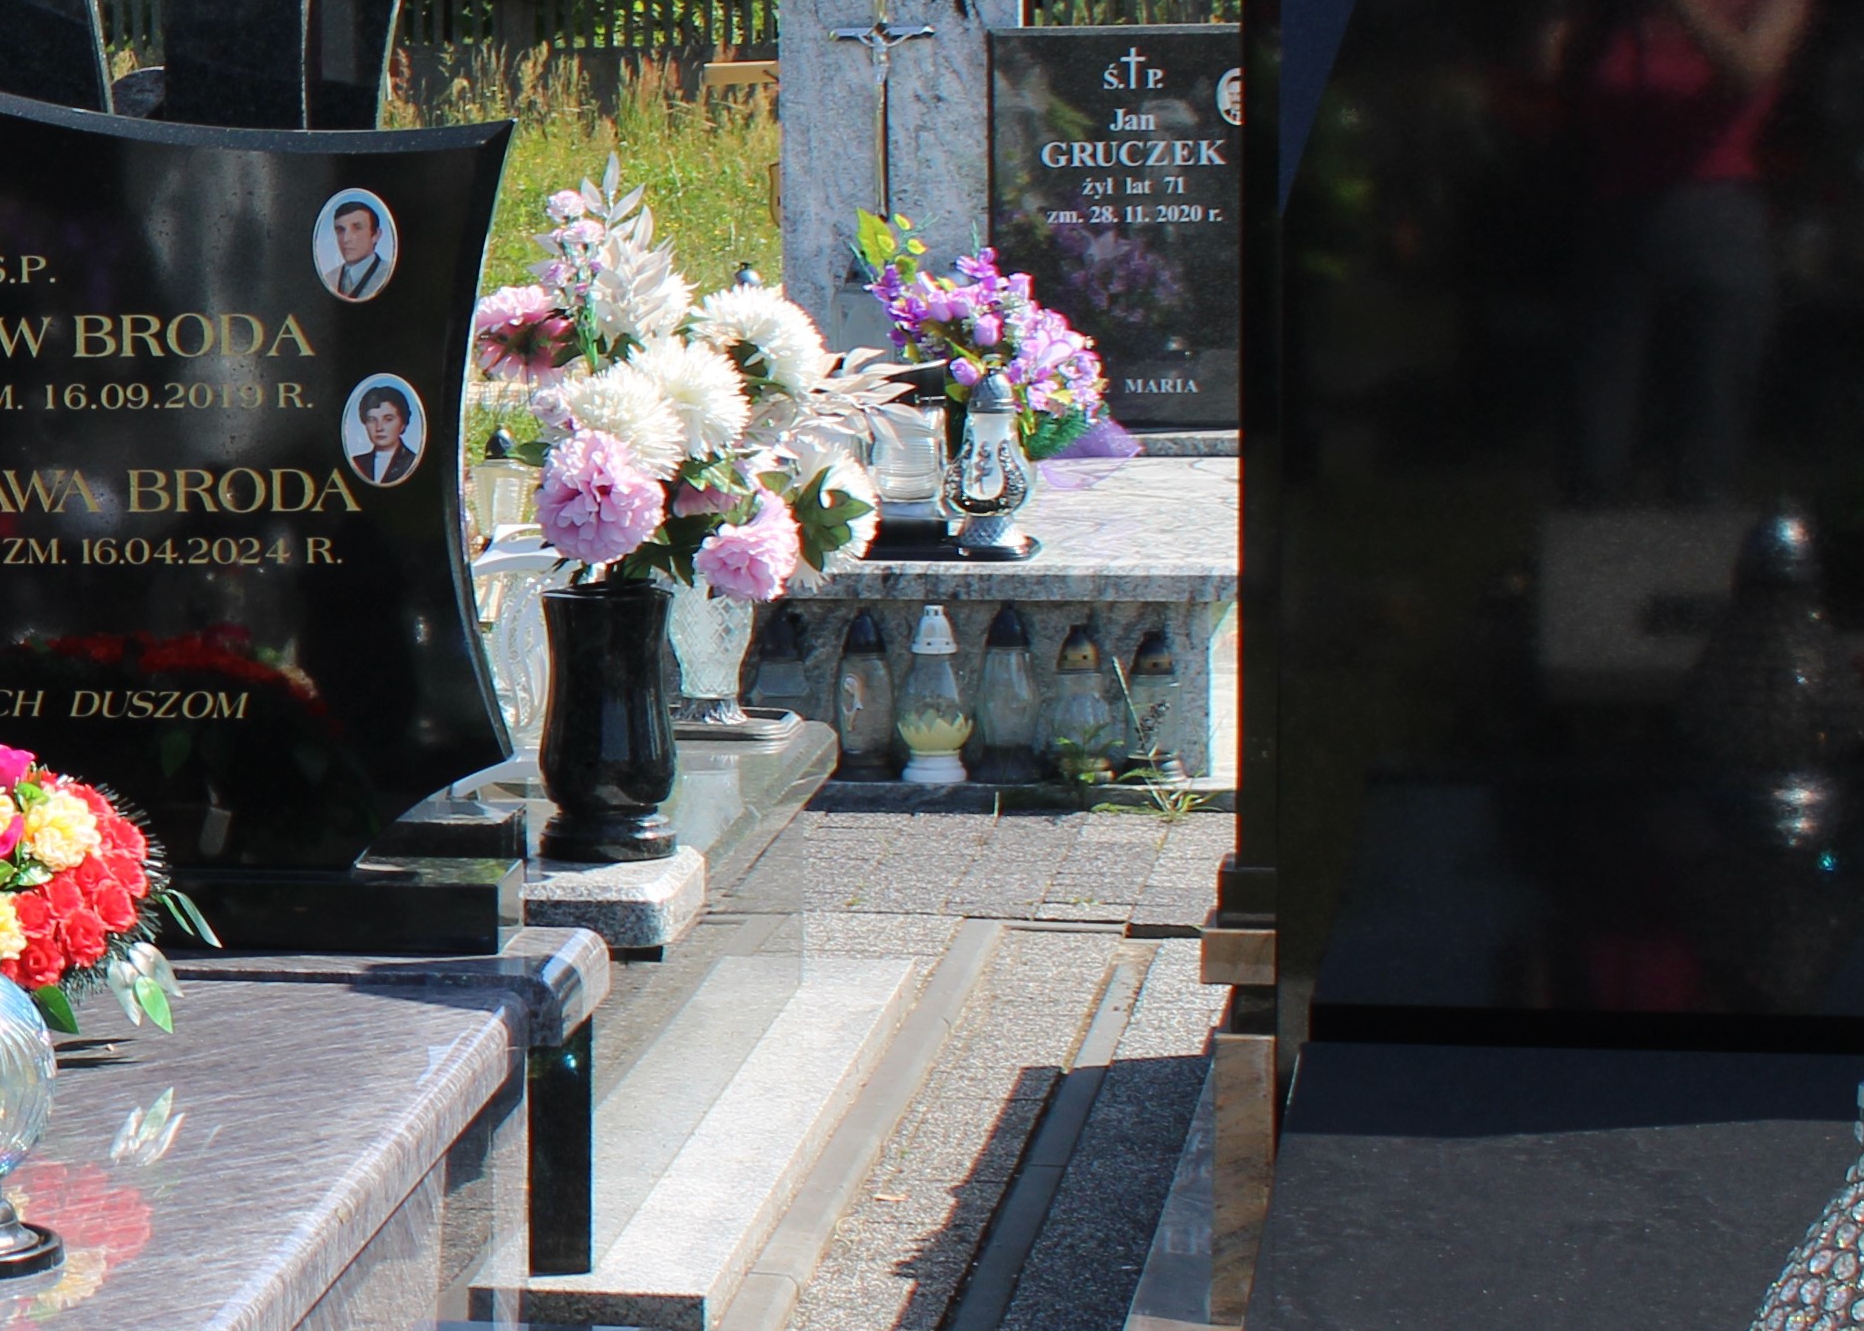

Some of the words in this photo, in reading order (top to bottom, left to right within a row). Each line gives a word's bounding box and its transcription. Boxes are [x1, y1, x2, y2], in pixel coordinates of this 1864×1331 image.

[1109, 108, 1156, 132] Jan
[1040, 140, 1227, 168] GRUCZEK
[1126, 177, 1152, 195] lat
[1163, 177, 1185, 195] 71
[1047, 210, 1084, 224] zm.
[1089, 205, 1119, 224] 28.
[1125, 205, 1148, 223] 11.
[1156, 204, 1203, 222] 2020
[1208, 209, 1223, 222] r.
[73, 313, 316, 358] BRODA
[45, 382, 264, 410] 16.09.2019
[277, 382, 314, 409] R.
[1124, 378, 1199, 393] MARIA
[127, 468, 362, 513] BRODA
[2, 537, 67, 565] ZM.
[82, 536, 291, 565] 16.04.2024
[306, 536, 343, 564] R.
[70, 690, 250, 719] DUSZOM
